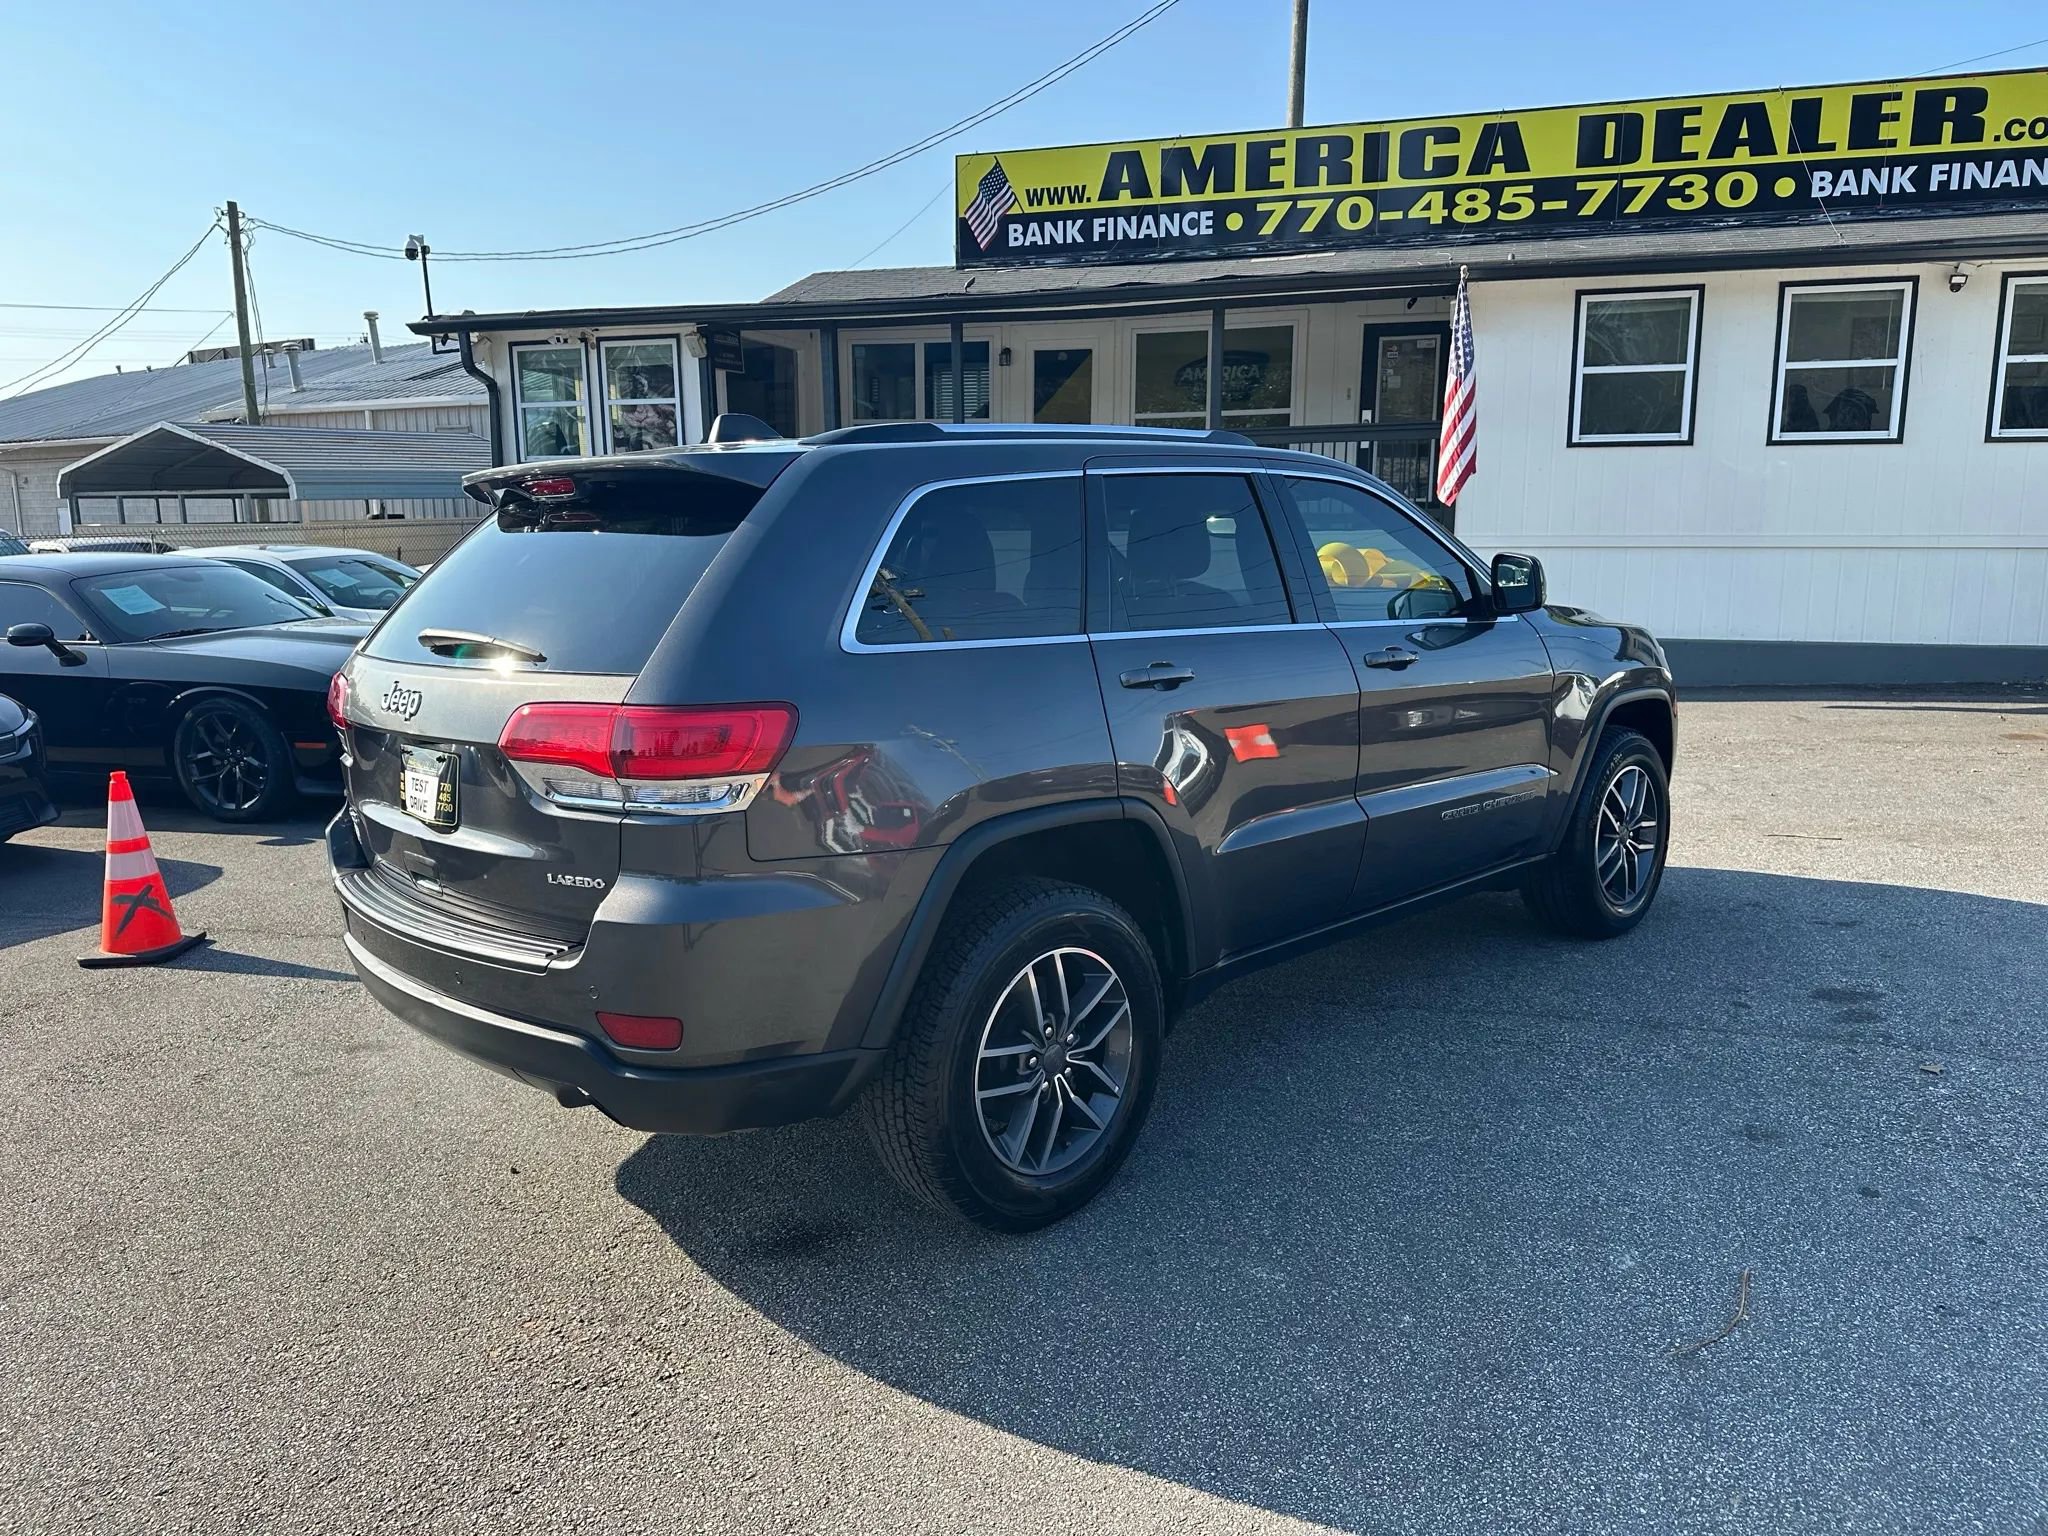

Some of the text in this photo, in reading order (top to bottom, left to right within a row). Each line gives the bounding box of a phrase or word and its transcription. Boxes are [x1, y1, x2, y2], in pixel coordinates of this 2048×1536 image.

[1025, 184, 1092, 207] www.
[1097, 119, 1531, 202] AMERICA
[1576, 87, 1989, 168] DEALER
[1008, 157, 2048, 247] BANK FINANCE 770-485-7730 BANK FINAN
[1181, 363, 1260, 382] AMRICA
[381, 680, 422, 721] Jeep
[411, 777, 429, 794] TEST
[409, 795, 429, 814] DRIVE
[547, 873, 606, 889] LAREDO
